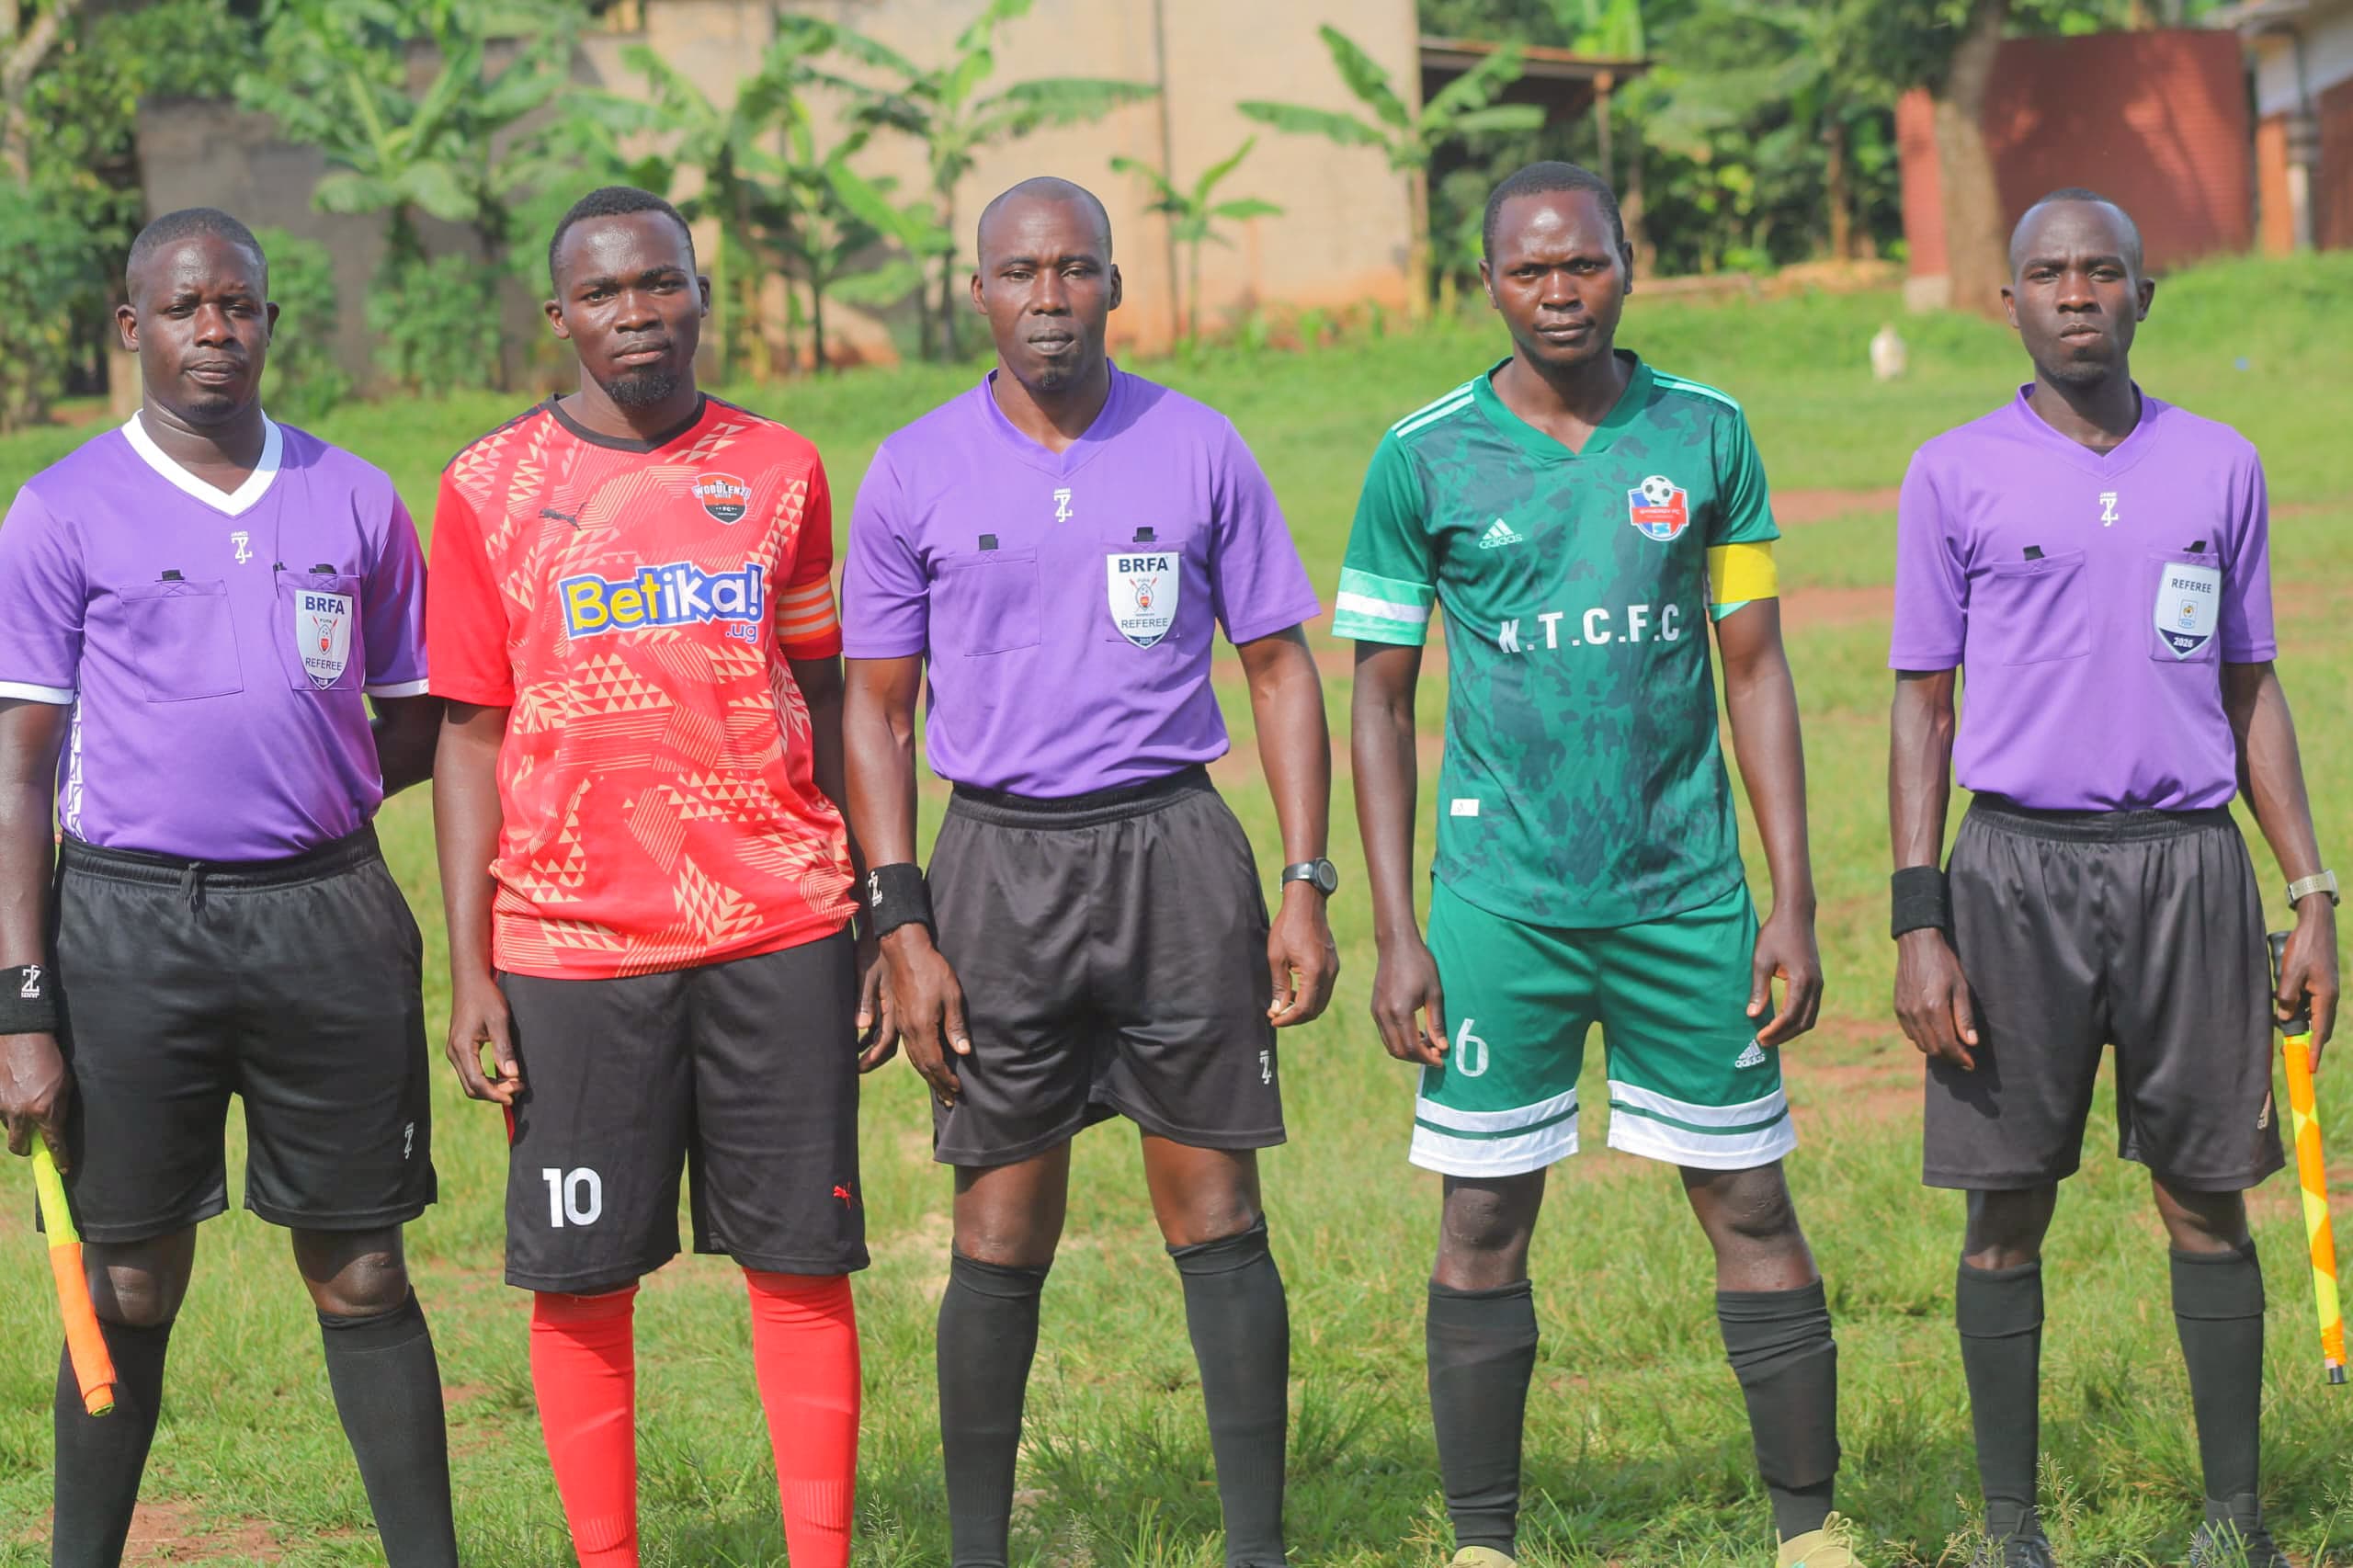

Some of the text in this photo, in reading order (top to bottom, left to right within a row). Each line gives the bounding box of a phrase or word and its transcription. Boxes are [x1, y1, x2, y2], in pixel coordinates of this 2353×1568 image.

[1479, 533, 1523, 550] adidas
[1118, 557, 1169, 573] BRFA
[2171, 578, 2212, 594] REFEREE
[305, 596, 345, 615] BRFA
[566, 567, 759, 631] Betika!
[1121, 618, 1169, 629] REFEREE
[726, 624, 757, 642] .ug
[305, 657, 343, 671] REFEREE
[1455, 1017, 1489, 1077] 6
[542, 1166, 602, 1228] 10
